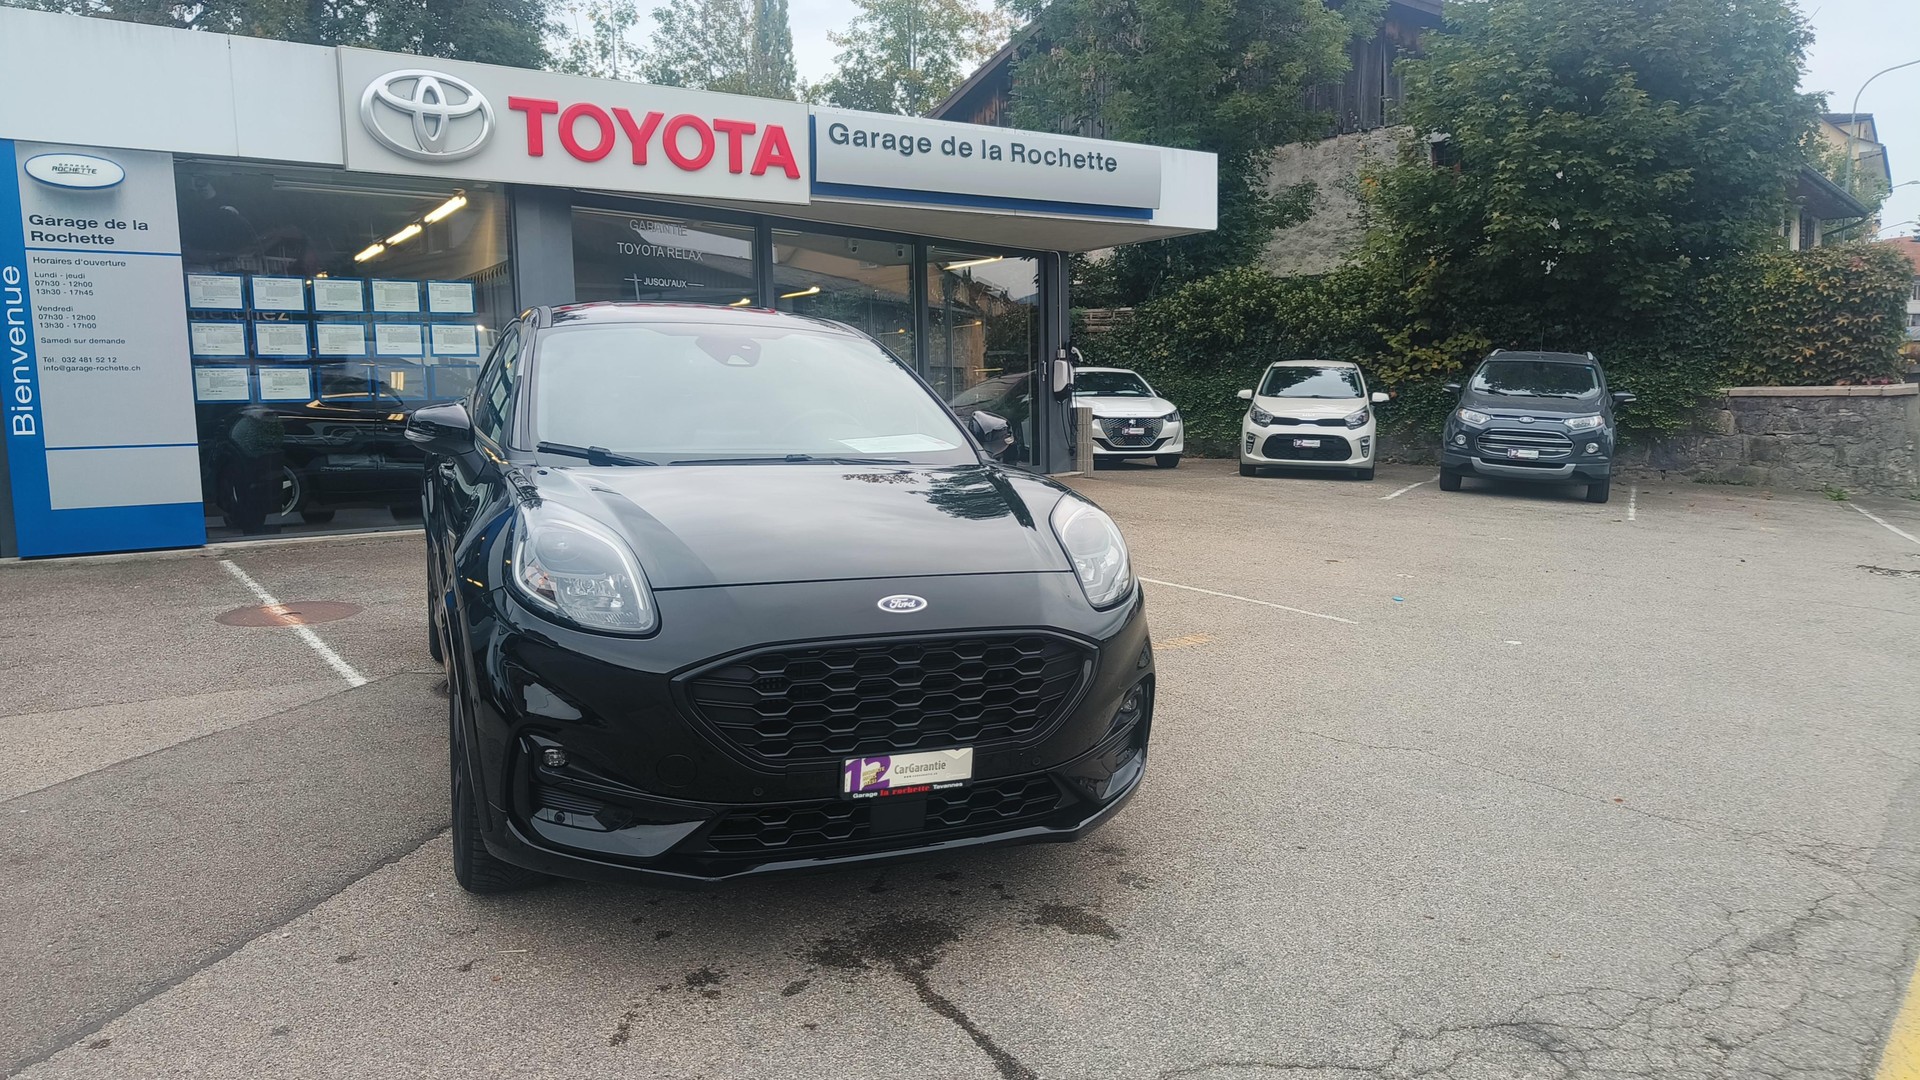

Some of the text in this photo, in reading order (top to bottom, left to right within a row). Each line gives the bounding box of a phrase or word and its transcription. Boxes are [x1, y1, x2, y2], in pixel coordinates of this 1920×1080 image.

[508, 95, 800, 180] TOYOTA
[828, 122, 1118, 172] Garage de la Rochette
[51, 165, 97, 175] ROCHETTE
[28, 214, 149, 231] Garage de la
[629, 219, 688, 237] GARANTIE
[30, 230, 115, 245] Rochette
[616, 242, 704, 262] TOYOTA RELAX
[32, 256, 127, 268] Horaires d'ouverture
[34, 271, 58, 279] Lundi
[34, 279, 60, 287] 07h30
[643, 277, 688, 289] JUSQU'AUX
[36, 288, 61, 296] 13h30
[69, 289, 94, 297] 17h45
[37, 305, 74, 313] Vendredi
[38, 313, 64, 321] 07h30
[39, 322, 65, 330] 13h30
[73, 322, 97, 330] 17h00
[40, 337, 72, 345] Samedi
[88, 337, 126, 345] demande
[2, 265, 36, 436] Bienvenue
[61, 356, 77, 364] 032
[79, 356, 92, 364] 481
[95, 356, 105, 364] 52
[107, 356, 117, 364] 12
[43, 364, 141, 373] info@garage-rochette.ch
[889, 598, 916, 609] Ford
[844, 755, 891, 792] 12
[894, 760, 947, 775] CarGarantie
[852, 790, 879, 799] Garage
